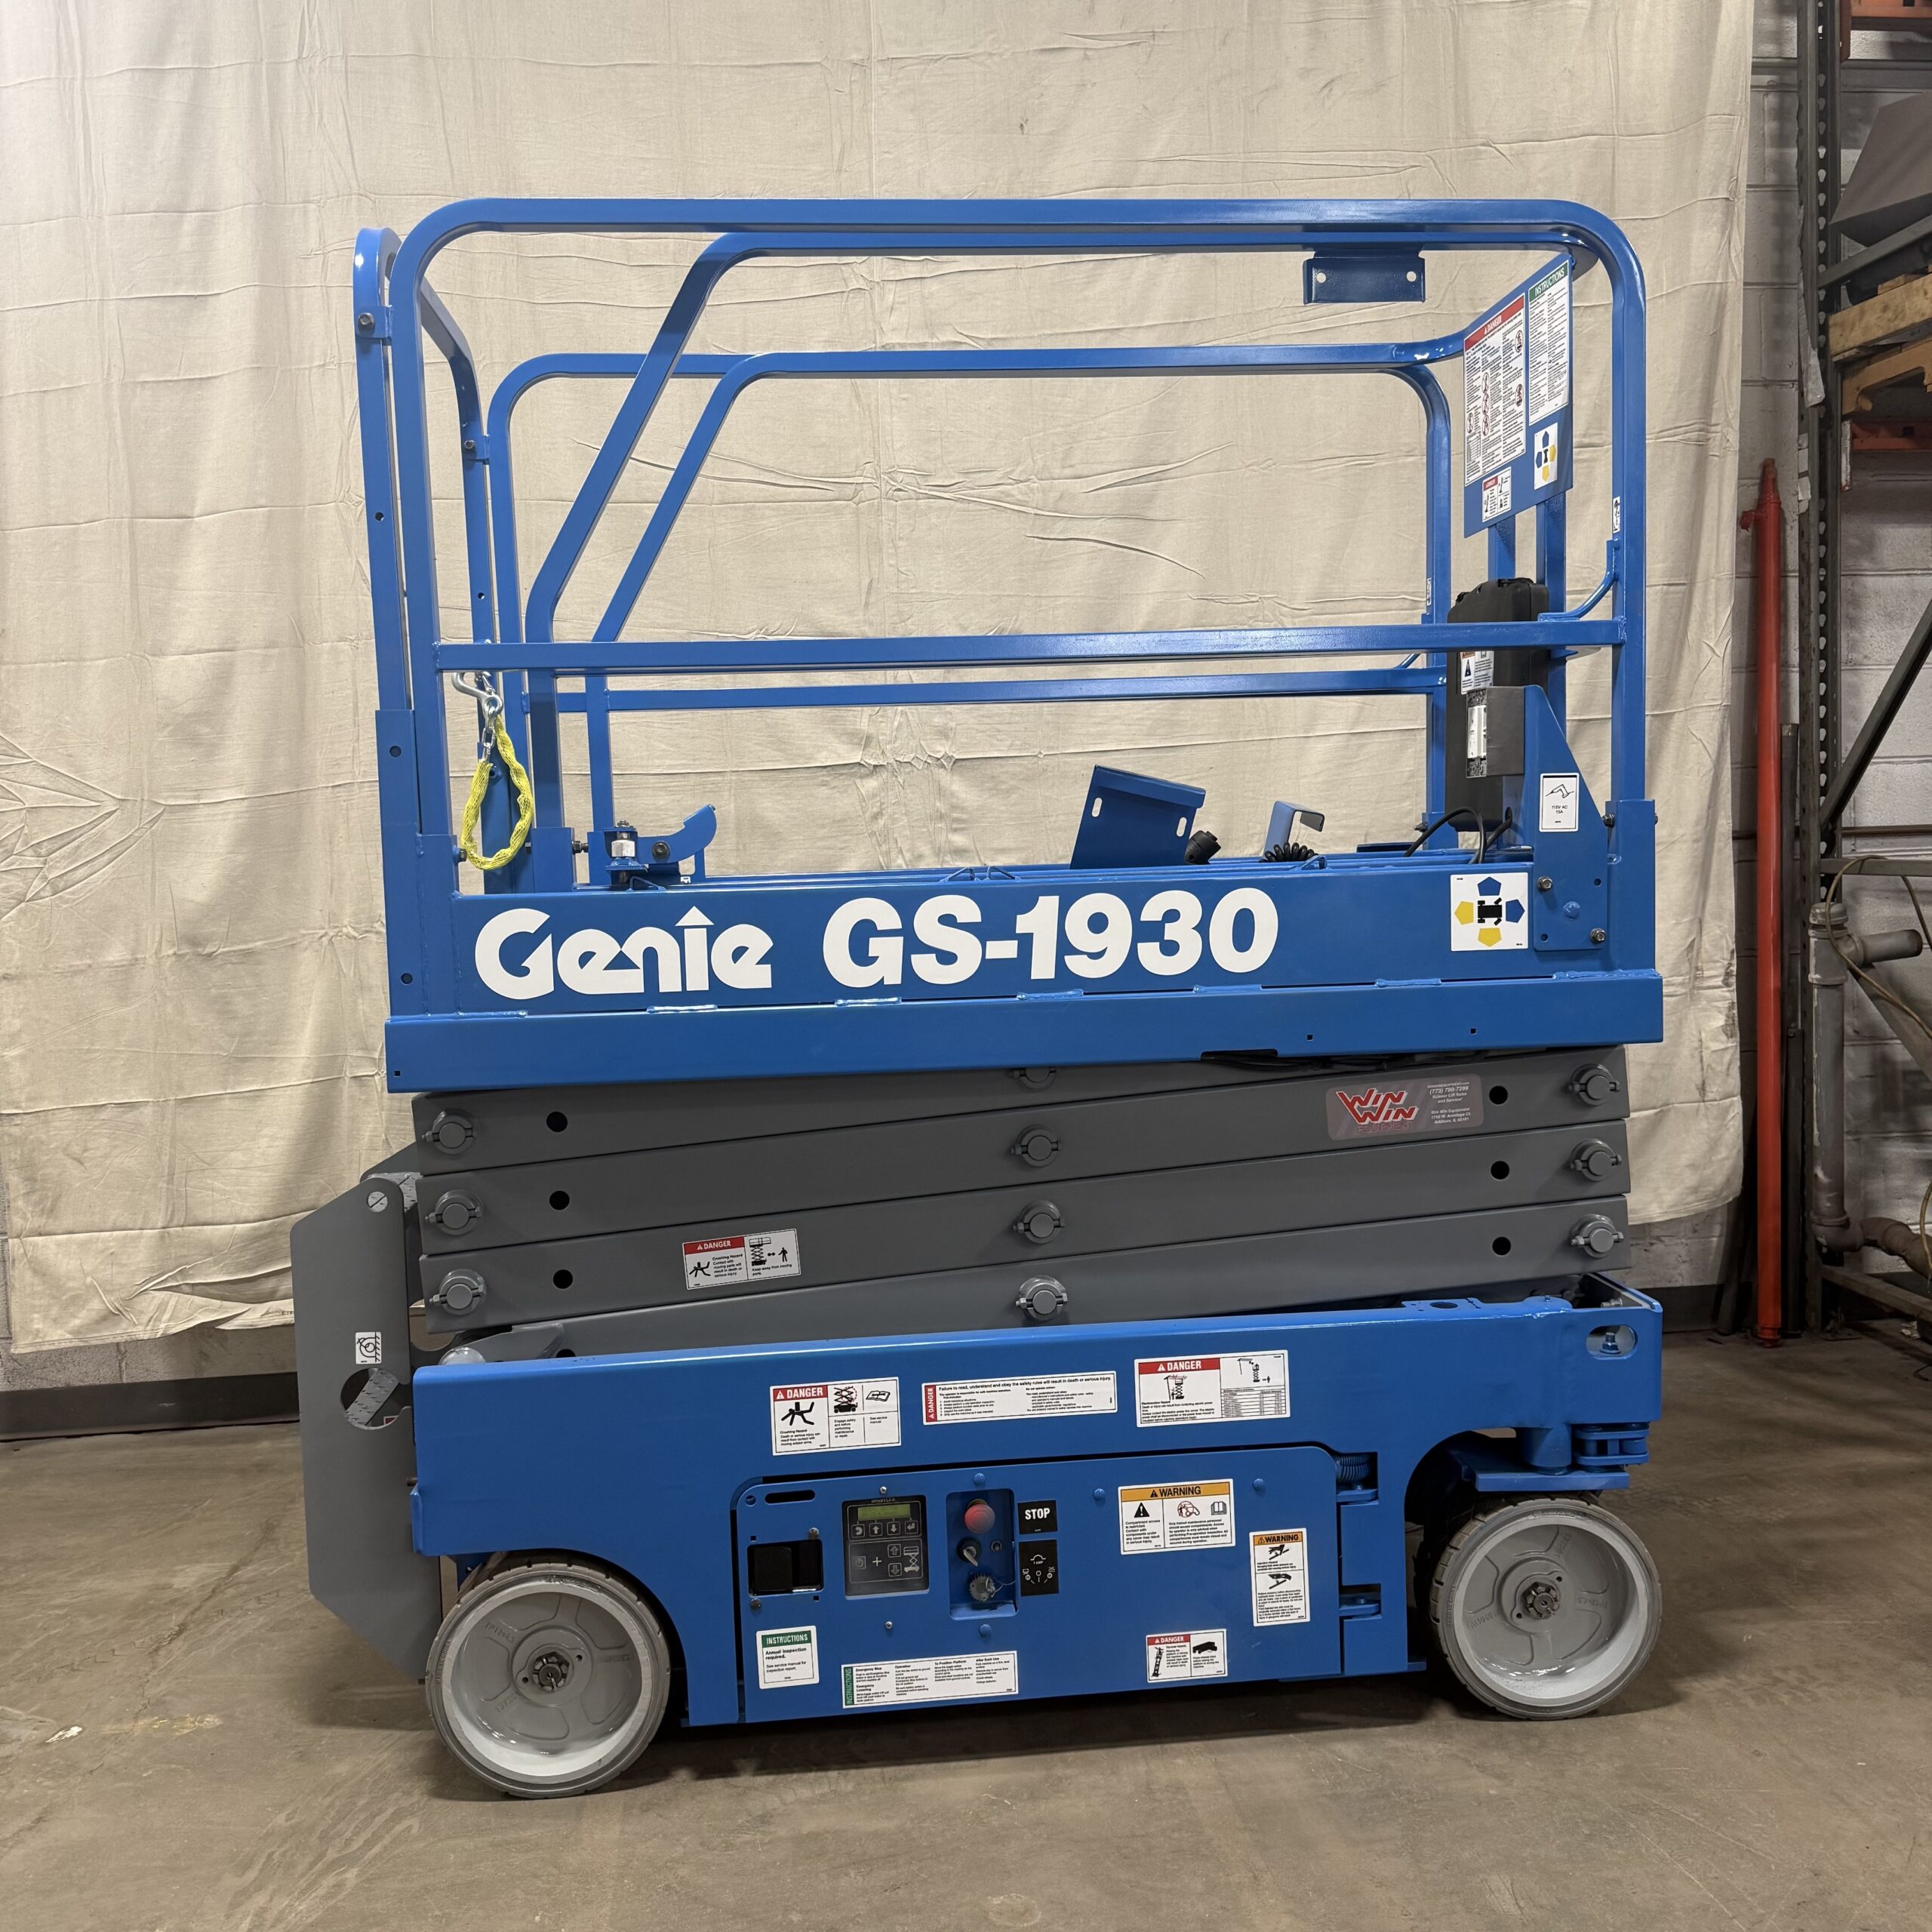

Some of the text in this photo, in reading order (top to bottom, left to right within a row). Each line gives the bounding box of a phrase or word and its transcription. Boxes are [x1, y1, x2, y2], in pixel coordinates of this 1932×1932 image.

[475, 888, 1278, 1000] Genie GS-1930
[703, 1241, 731, 1250] DANGER
[1167, 1361, 1201, 1371] DANGER
[786, 1388, 823, 1398] DANGER
[1159, 1486, 1201, 1497] WARNING
[1025, 1508, 1051, 1520] STOP
[1265, 1534, 1299, 1543] WARNING
[766, 1634, 808, 1644] INSTRUCTIONS
